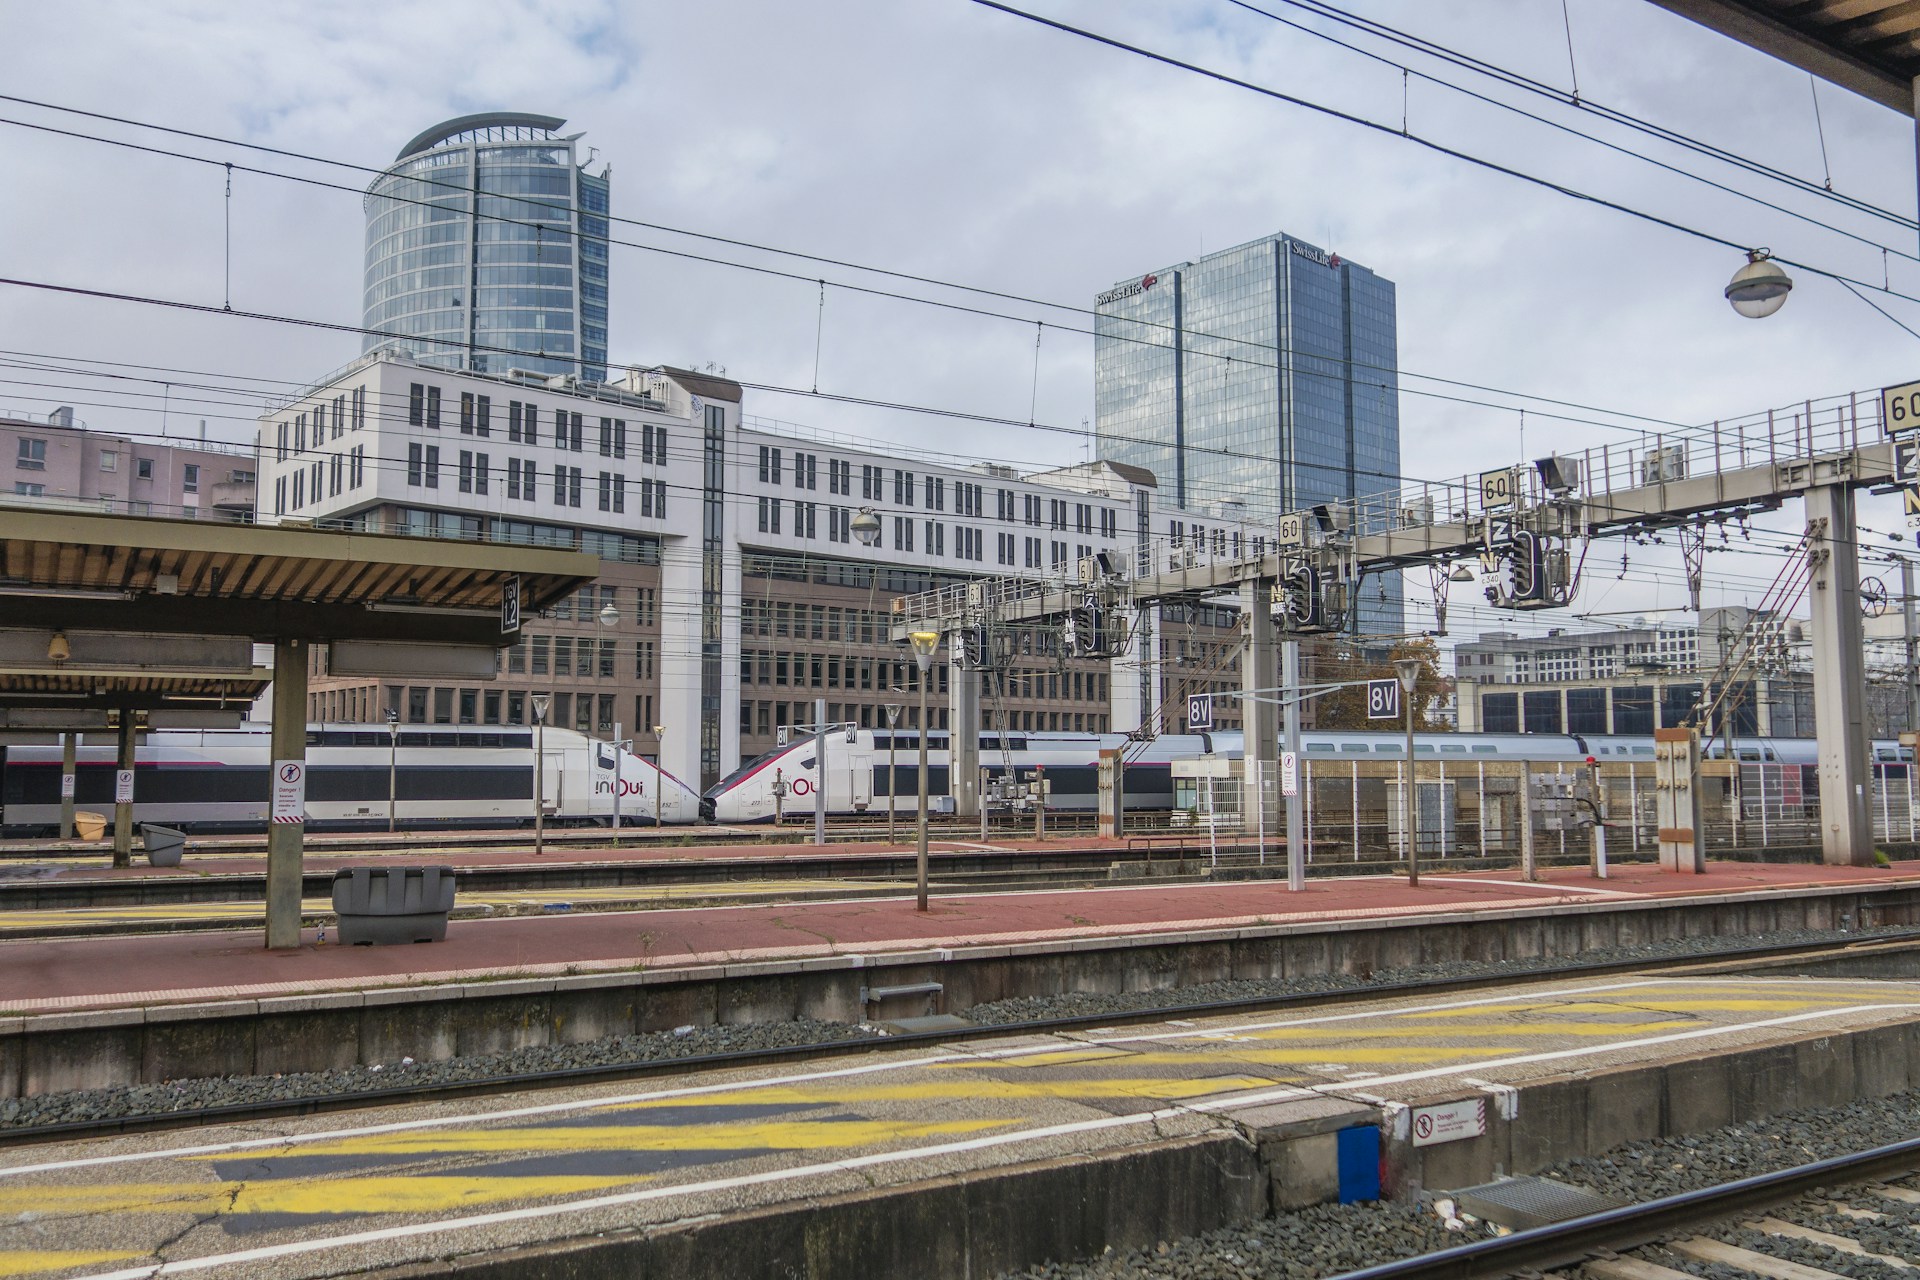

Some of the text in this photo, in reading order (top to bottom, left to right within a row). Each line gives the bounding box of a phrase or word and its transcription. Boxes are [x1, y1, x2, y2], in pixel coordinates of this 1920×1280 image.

[1485, 478, 1505, 500] 60
[1282, 521, 1298, 538] 60
[1492, 520, 1509, 541] Z
[505, 582, 517, 600] TGV
[1371, 686, 1394, 711] 8V
[1191, 700, 1208, 722] 8V
